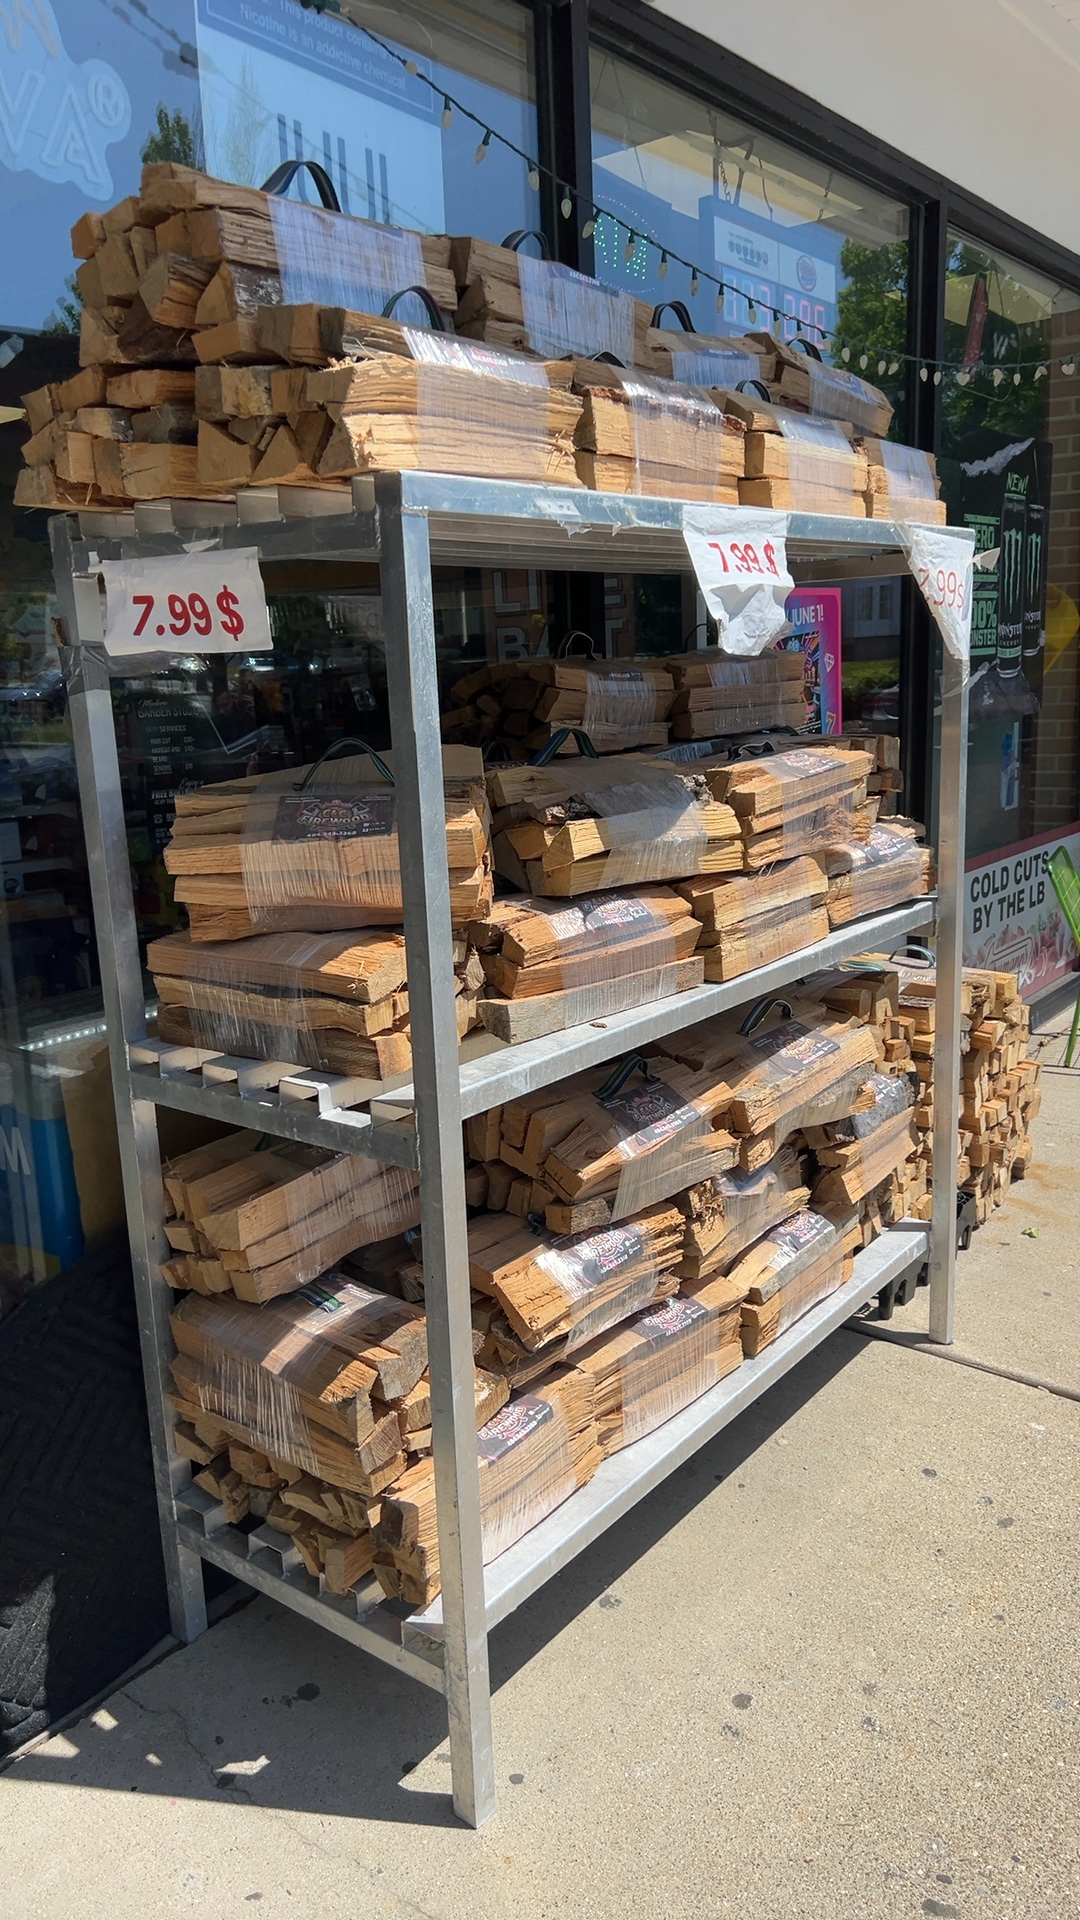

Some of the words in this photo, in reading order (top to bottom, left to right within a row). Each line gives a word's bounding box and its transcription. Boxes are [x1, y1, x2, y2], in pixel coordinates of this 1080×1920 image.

[303, 9, 345, 40] product
[239, 4, 286, 35] Nicotine
[288, 26, 298, 41] is
[301, 32, 314, 50] an
[316, 40, 363, 70] addictive
[1006, 472, 1029, 494] NEW!
[707, 539, 780, 579] 7.99$
[132, 584, 244, 641] 7.99$
[791, 605, 816, 626] JUNE
[970, 628, 996, 646] ONSTER
[138, 708, 172, 718] BARBER
[159, 725, 187, 733] SERVICES
[151, 789, 168, 799] FREE
[300, 813, 371, 825] FIREWOOD
[970, 865, 1009, 903] COLD
[1014, 850, 1049, 886] CUTS
[973, 902, 993, 934] BY
[997, 890, 1025, 922] THE
[1029, 880, 1045, 909] LB
